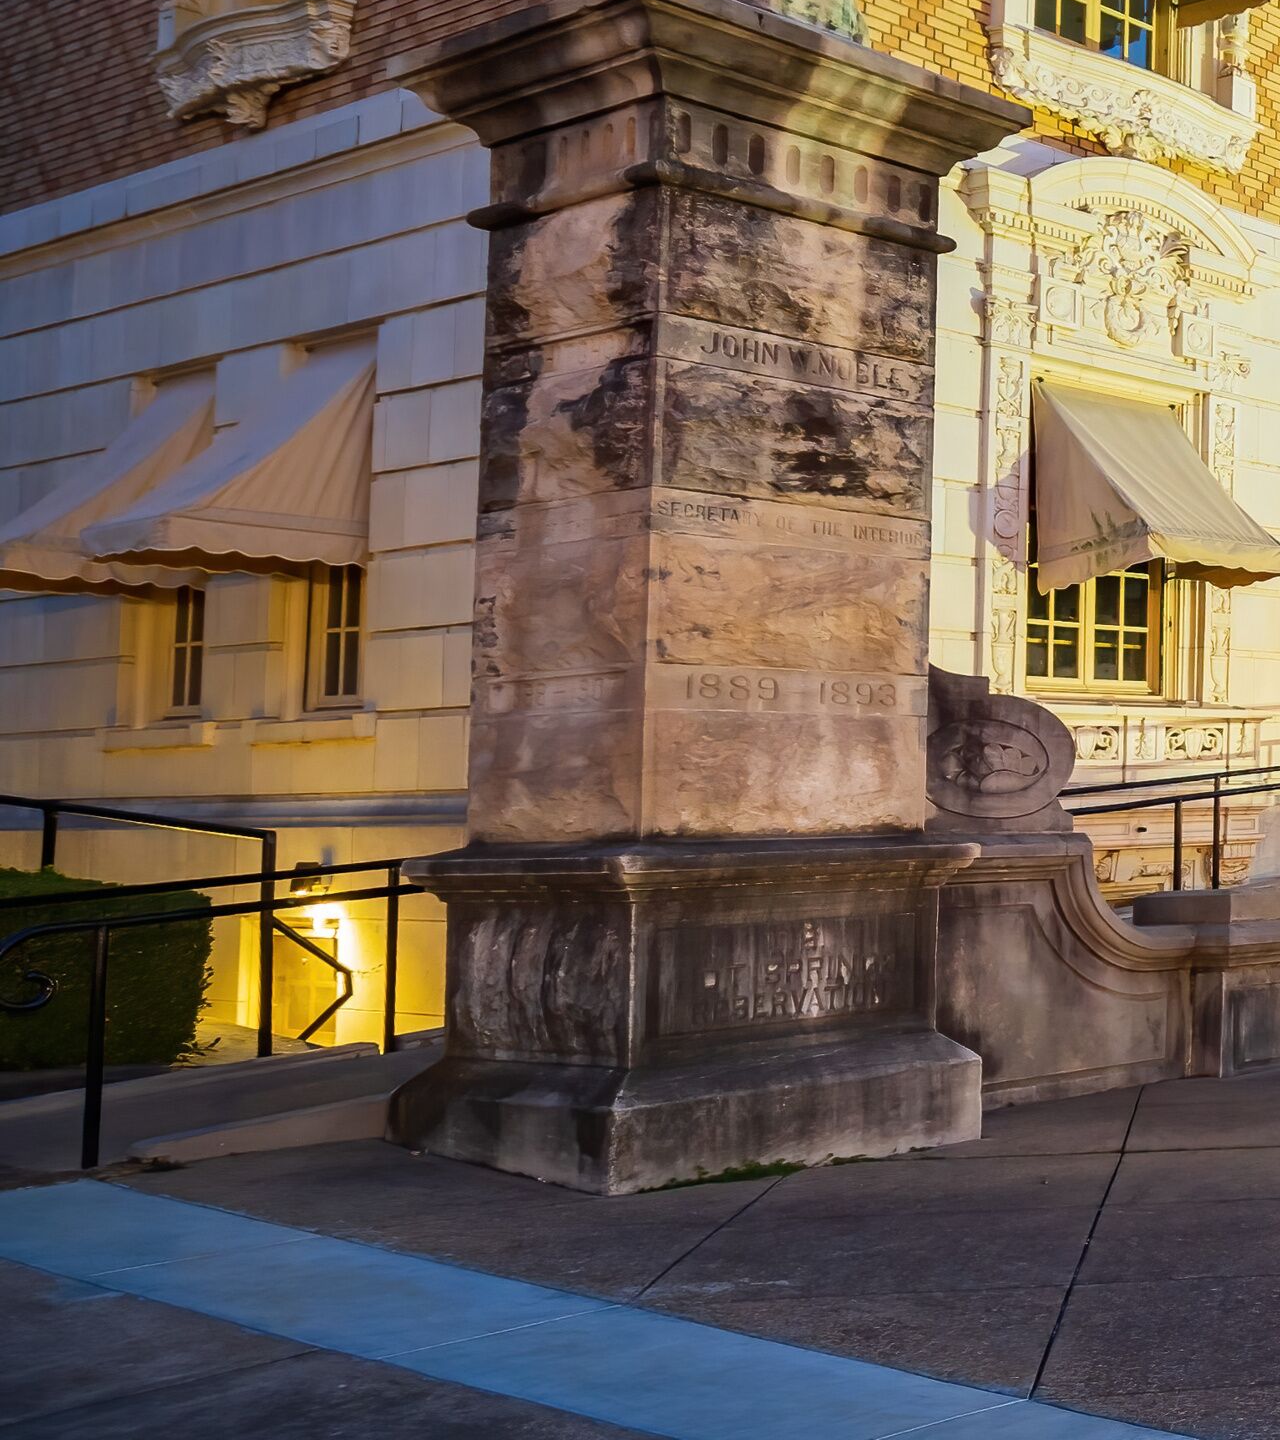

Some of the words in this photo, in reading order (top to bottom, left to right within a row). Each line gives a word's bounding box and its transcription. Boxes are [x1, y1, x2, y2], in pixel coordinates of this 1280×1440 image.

[700, 332, 779, 365] JOHN
[656, 500, 763, 528] SECRETARY
[775, 512, 794, 531] OF
[810, 518, 843, 538] THE
[686, 672, 780, 701] 1889
[818, 678, 897, 707] 1893
